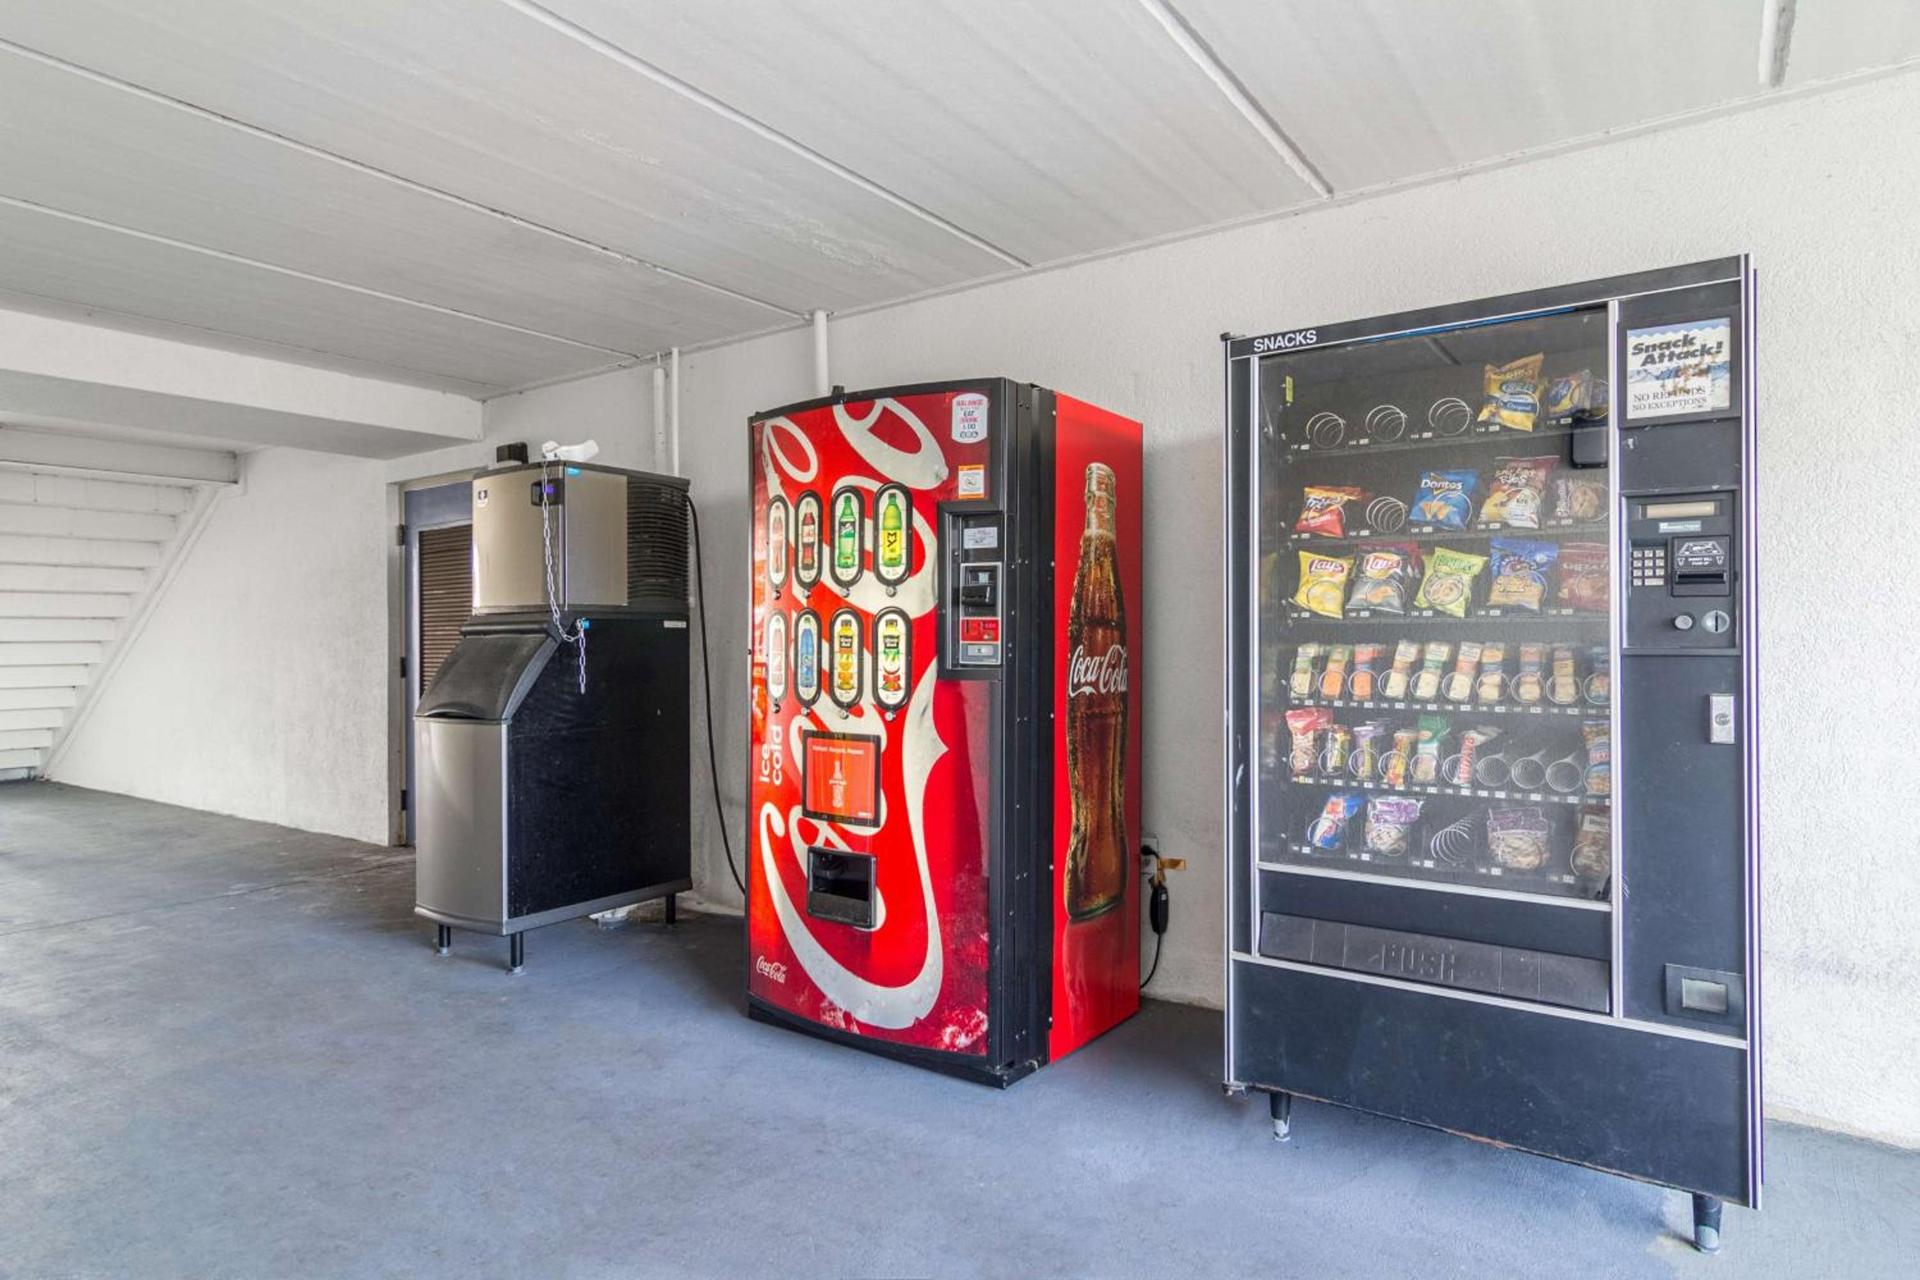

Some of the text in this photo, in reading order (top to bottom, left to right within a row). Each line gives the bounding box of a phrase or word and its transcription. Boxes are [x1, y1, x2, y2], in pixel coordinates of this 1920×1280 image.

[1254, 330, 1317, 352] SNACKS
[1632, 334, 1697, 355] Snack
[1640, 341, 1724, 367] Attack!
[1632, 397, 1707, 412] NO EXCEPTIONS
[1633, 393, 1650, 403] NO
[1420, 479, 1463, 490] Doritos
[1069, 645, 1128, 698] Coca-Cola
[759, 744, 770, 783] Ice
[770, 725, 783, 786] cold
[756, 955, 787, 983] Coca-Cola
